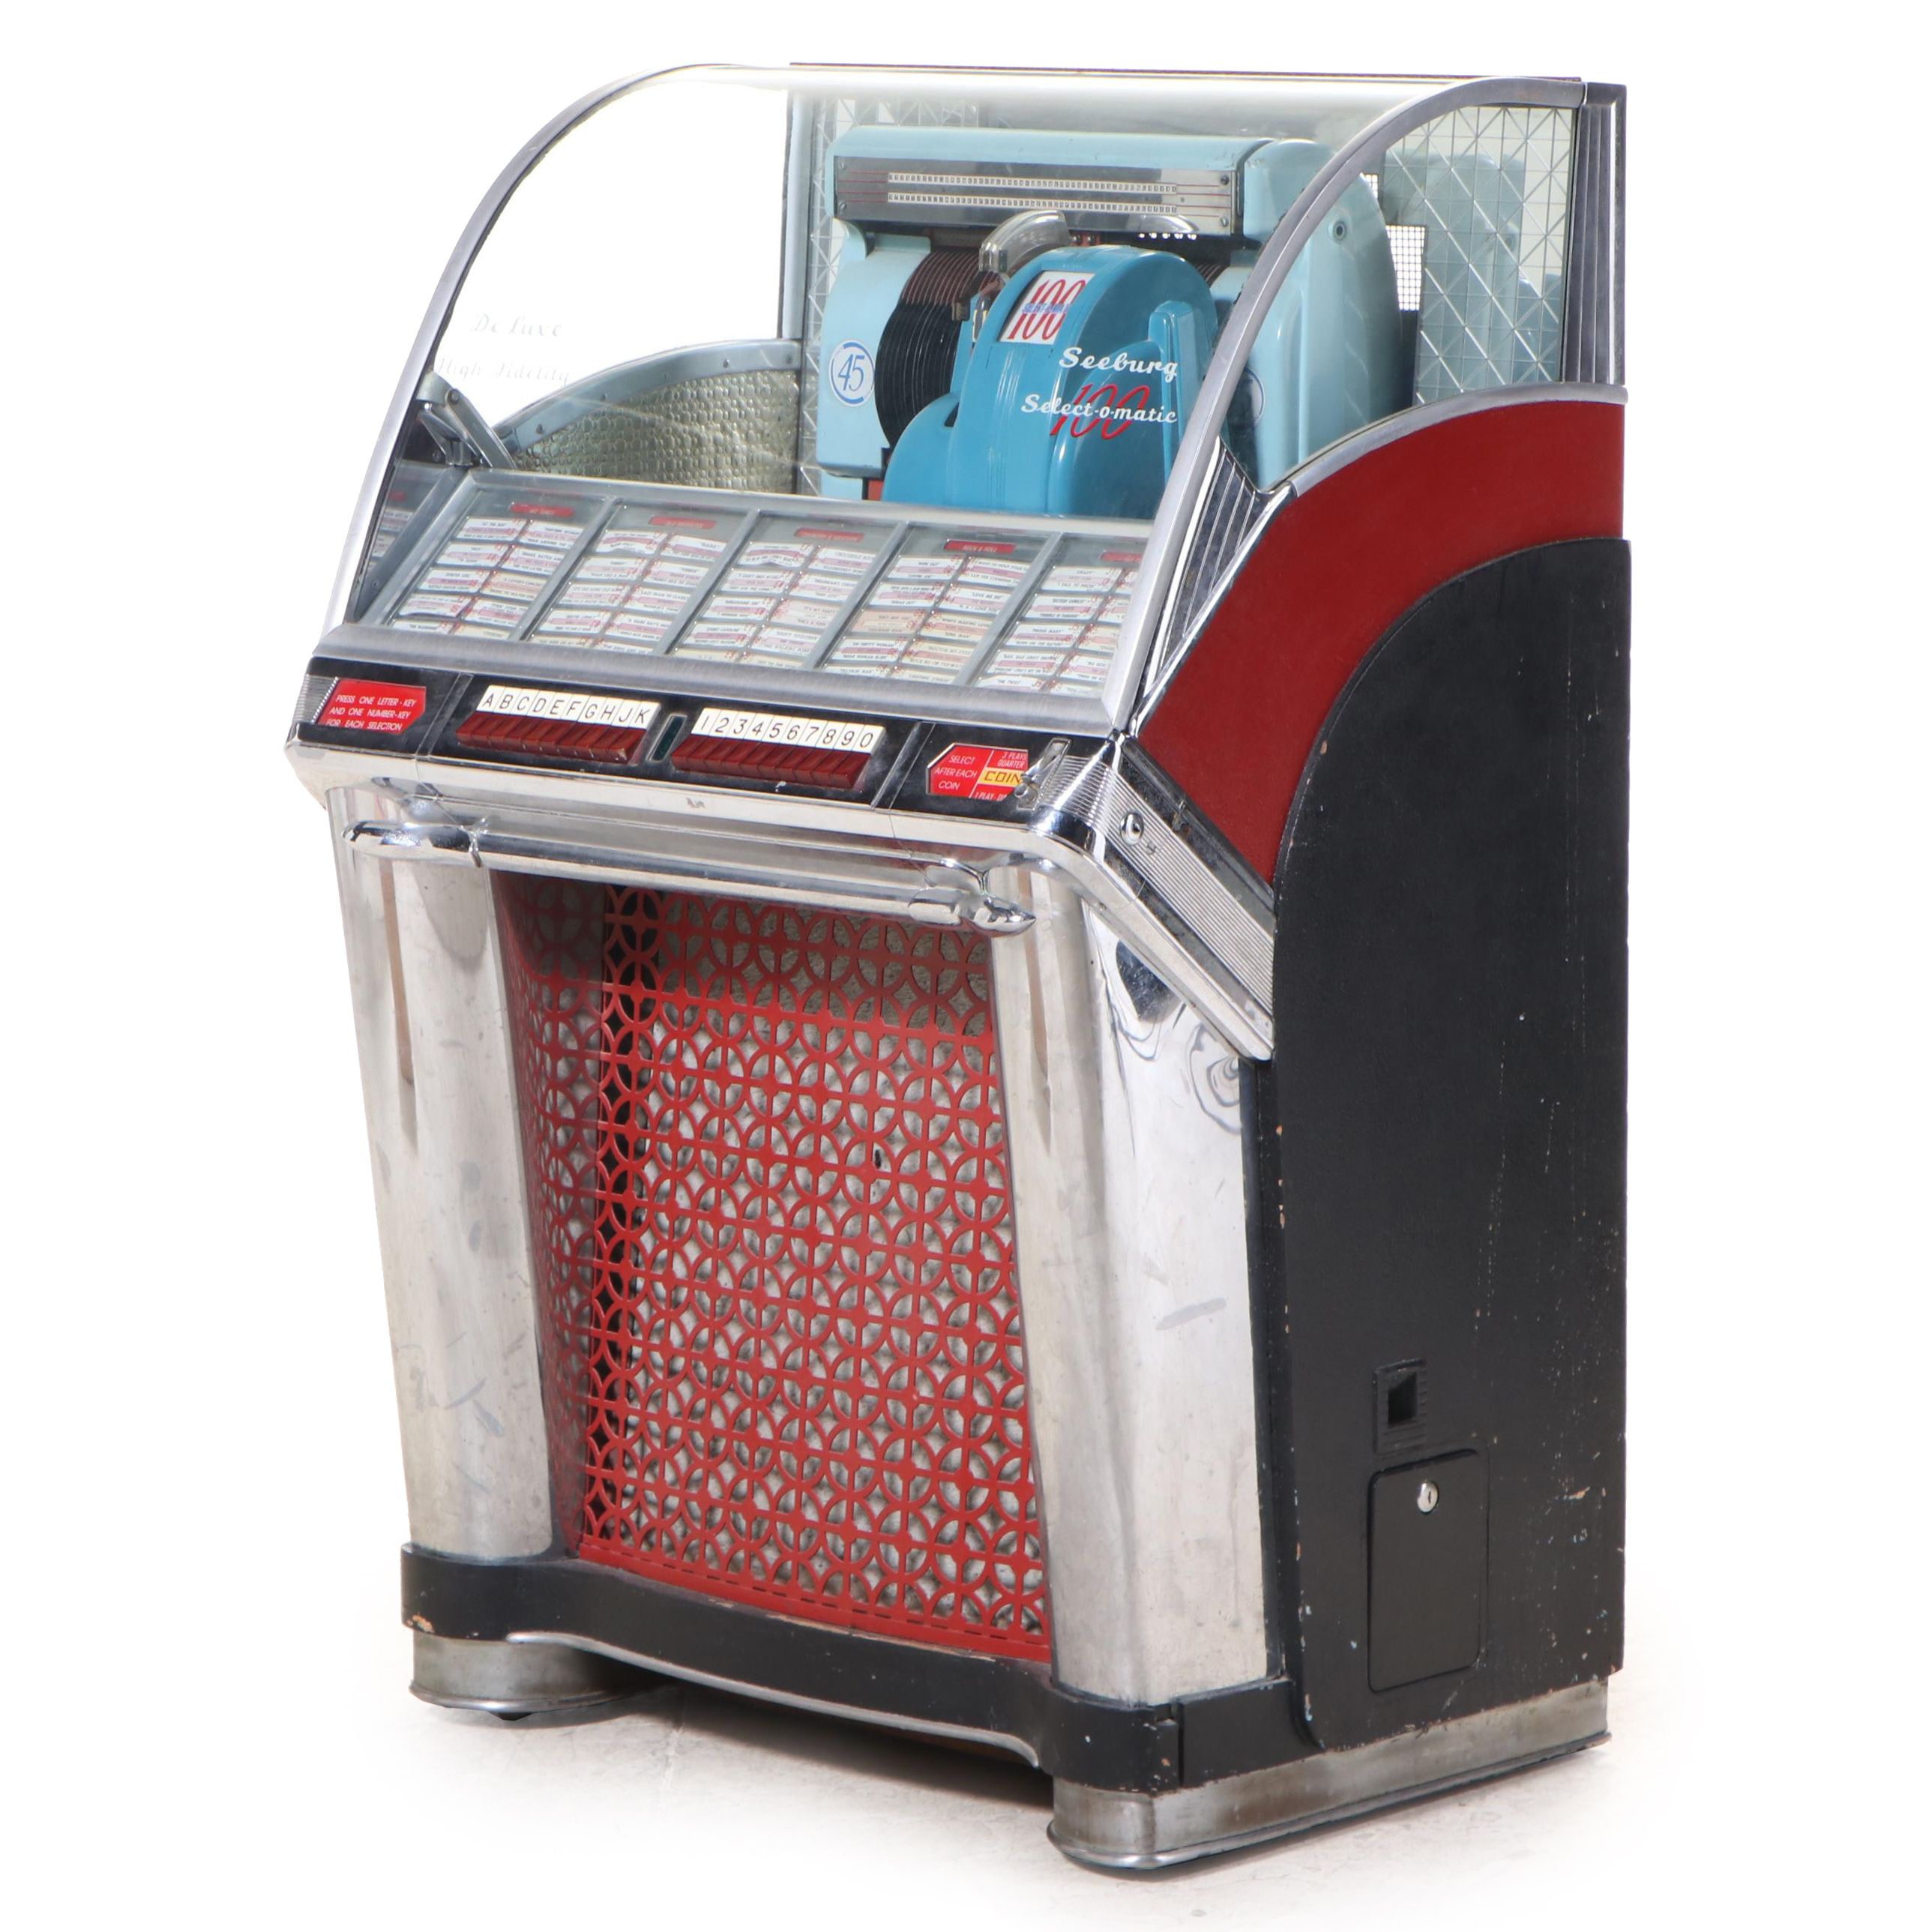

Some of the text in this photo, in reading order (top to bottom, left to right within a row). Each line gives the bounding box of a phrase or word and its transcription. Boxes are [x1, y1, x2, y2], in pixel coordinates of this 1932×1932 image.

[1007, 278, 1086, 340] 100
[1059, 347, 1178, 383] Seeburg
[837, 354, 865, 391] 45
[1050, 383, 1150, 440] 100
[335, 694, 356, 705] PRESS
[358, 696, 375, 705] ONE
[329, 707, 346, 715] AND
[348, 707, 364, 717] ONE
[326, 718, 403, 732] FOR EACH SELECTION
[949, 755, 975, 764] SELECT
[997, 759, 1025, 768] QUARTER
[936, 767, 977, 778] AFTER EACH
[938, 780, 960, 790] COIN
